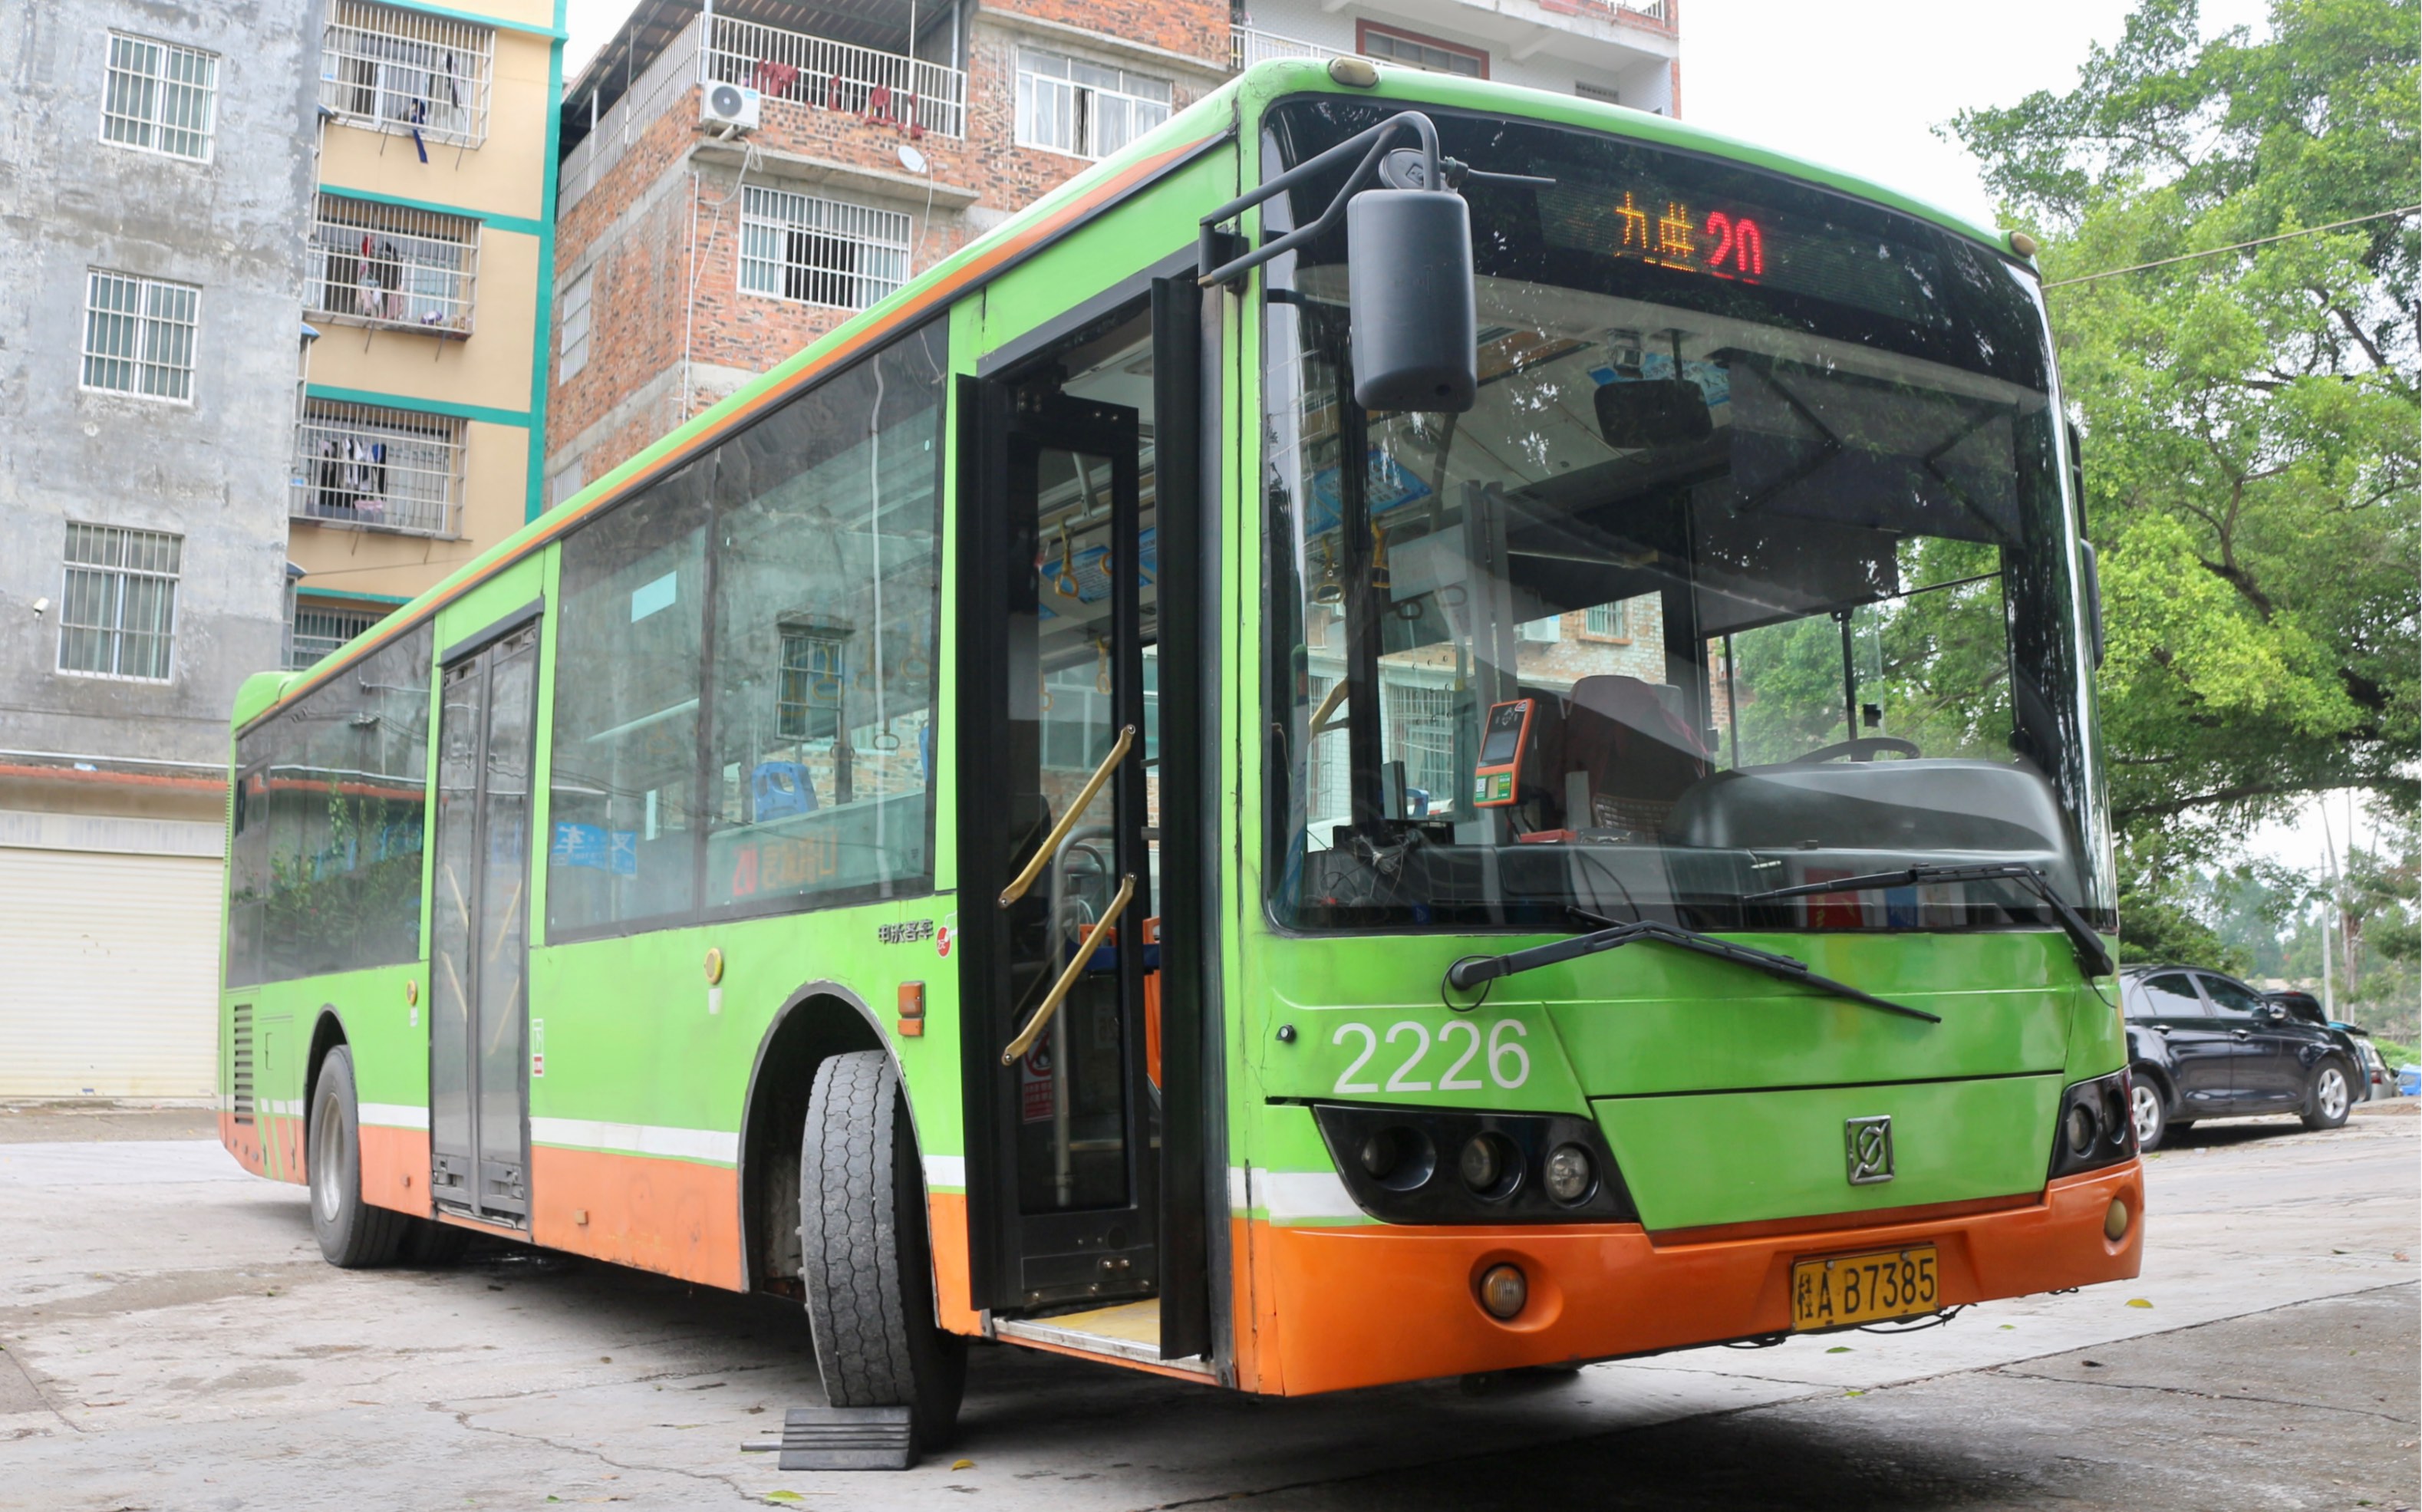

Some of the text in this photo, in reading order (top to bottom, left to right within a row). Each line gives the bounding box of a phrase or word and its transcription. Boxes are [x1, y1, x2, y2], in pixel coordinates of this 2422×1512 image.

[1705, 211, 1763, 285] 20
[878, 918, 934, 944] 申沃客车
[1332, 1018, 1531, 1095] 2226
